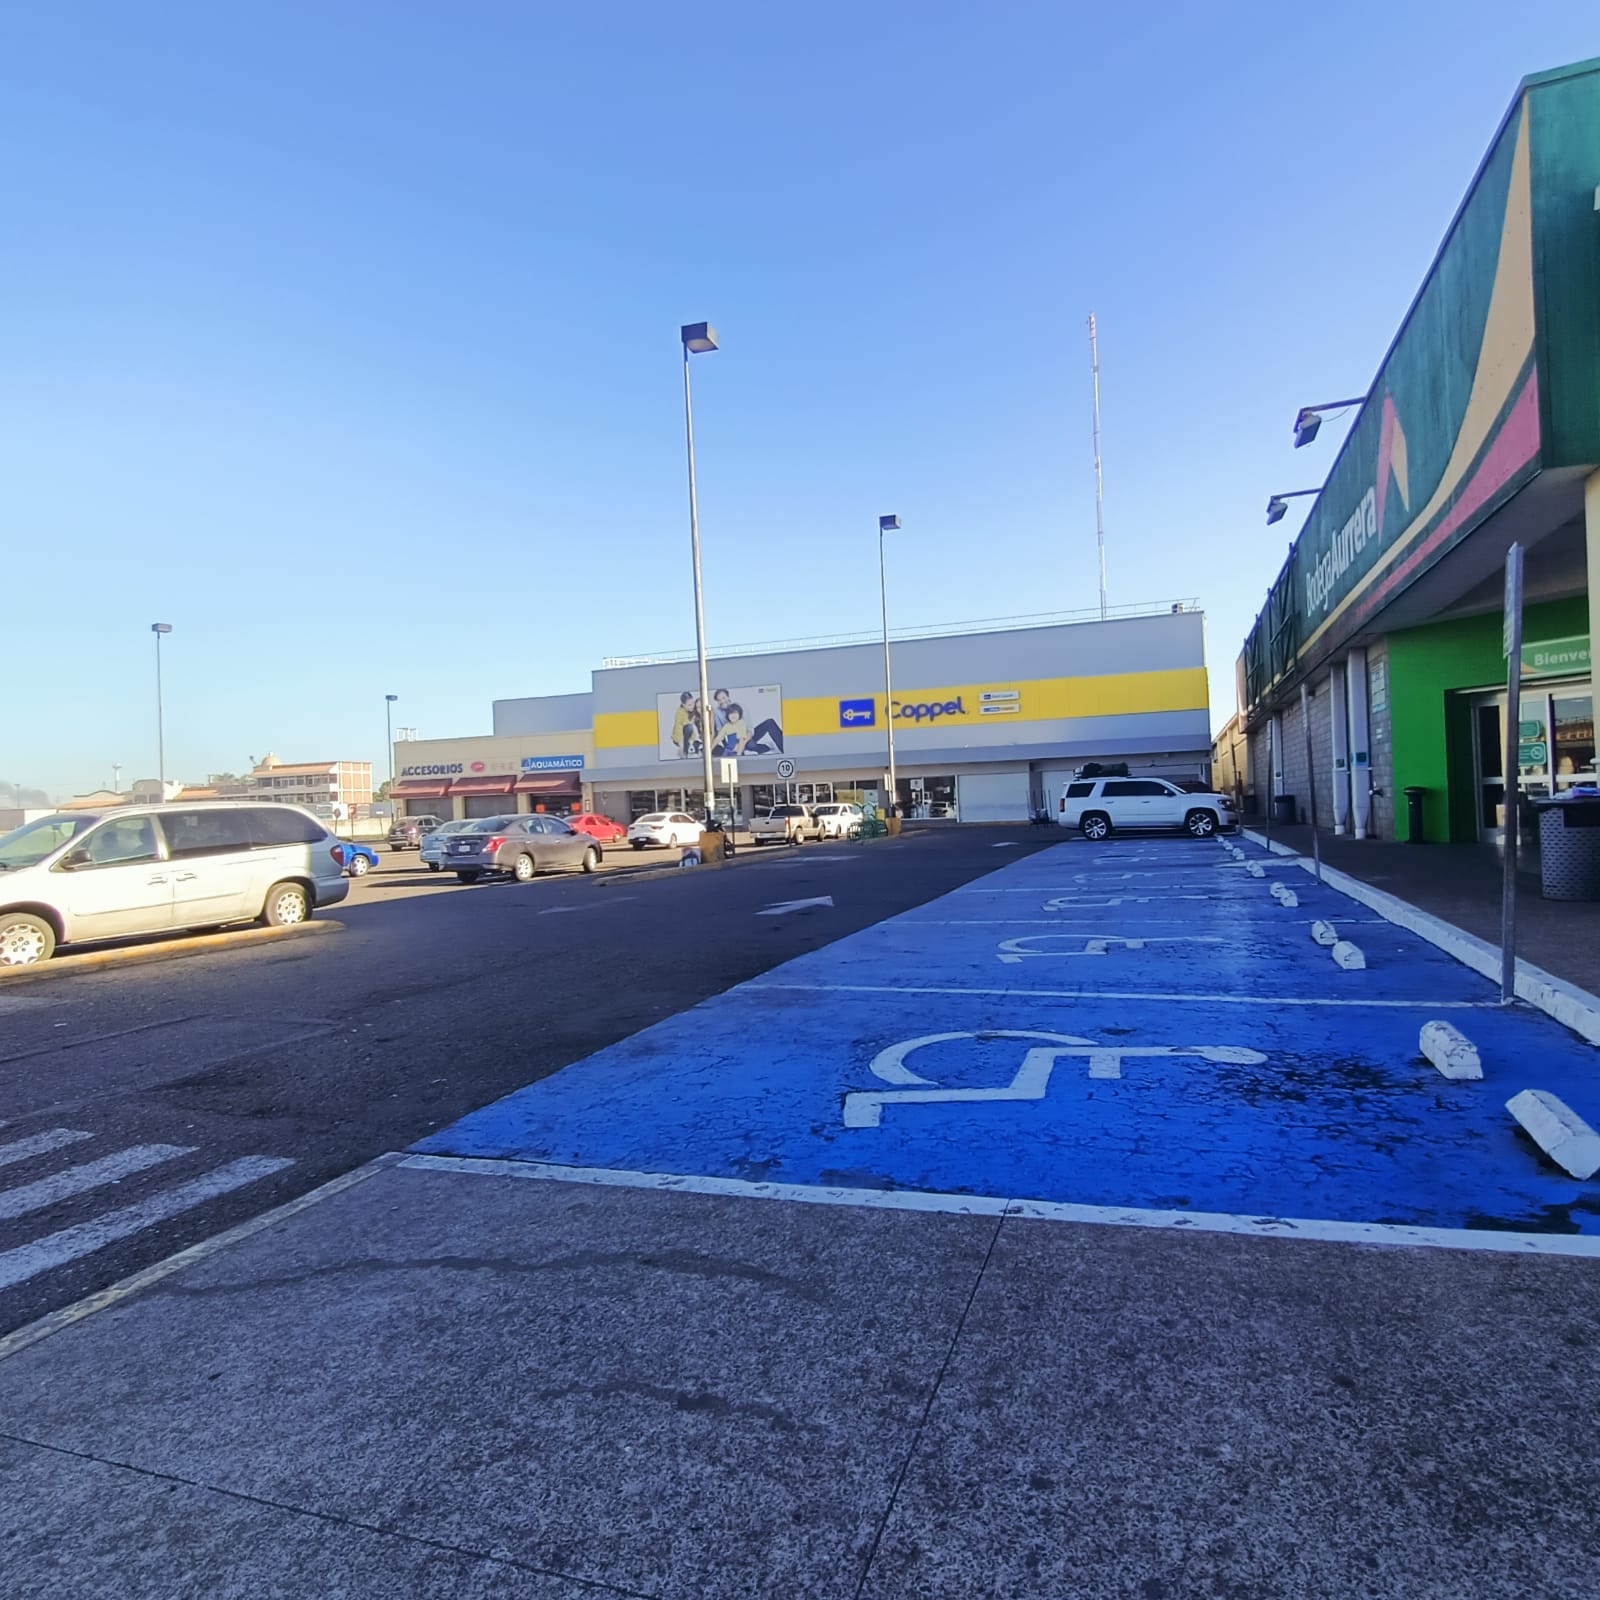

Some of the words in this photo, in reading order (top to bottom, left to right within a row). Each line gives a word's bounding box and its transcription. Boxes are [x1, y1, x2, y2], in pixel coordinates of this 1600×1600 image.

[1534, 649, 1591, 666] Bienve
[885, 696, 966, 722] Coppel
[401, 764, 463, 776] ACCESORIOS
[530, 759, 583, 769] AQUAMÁTICO
